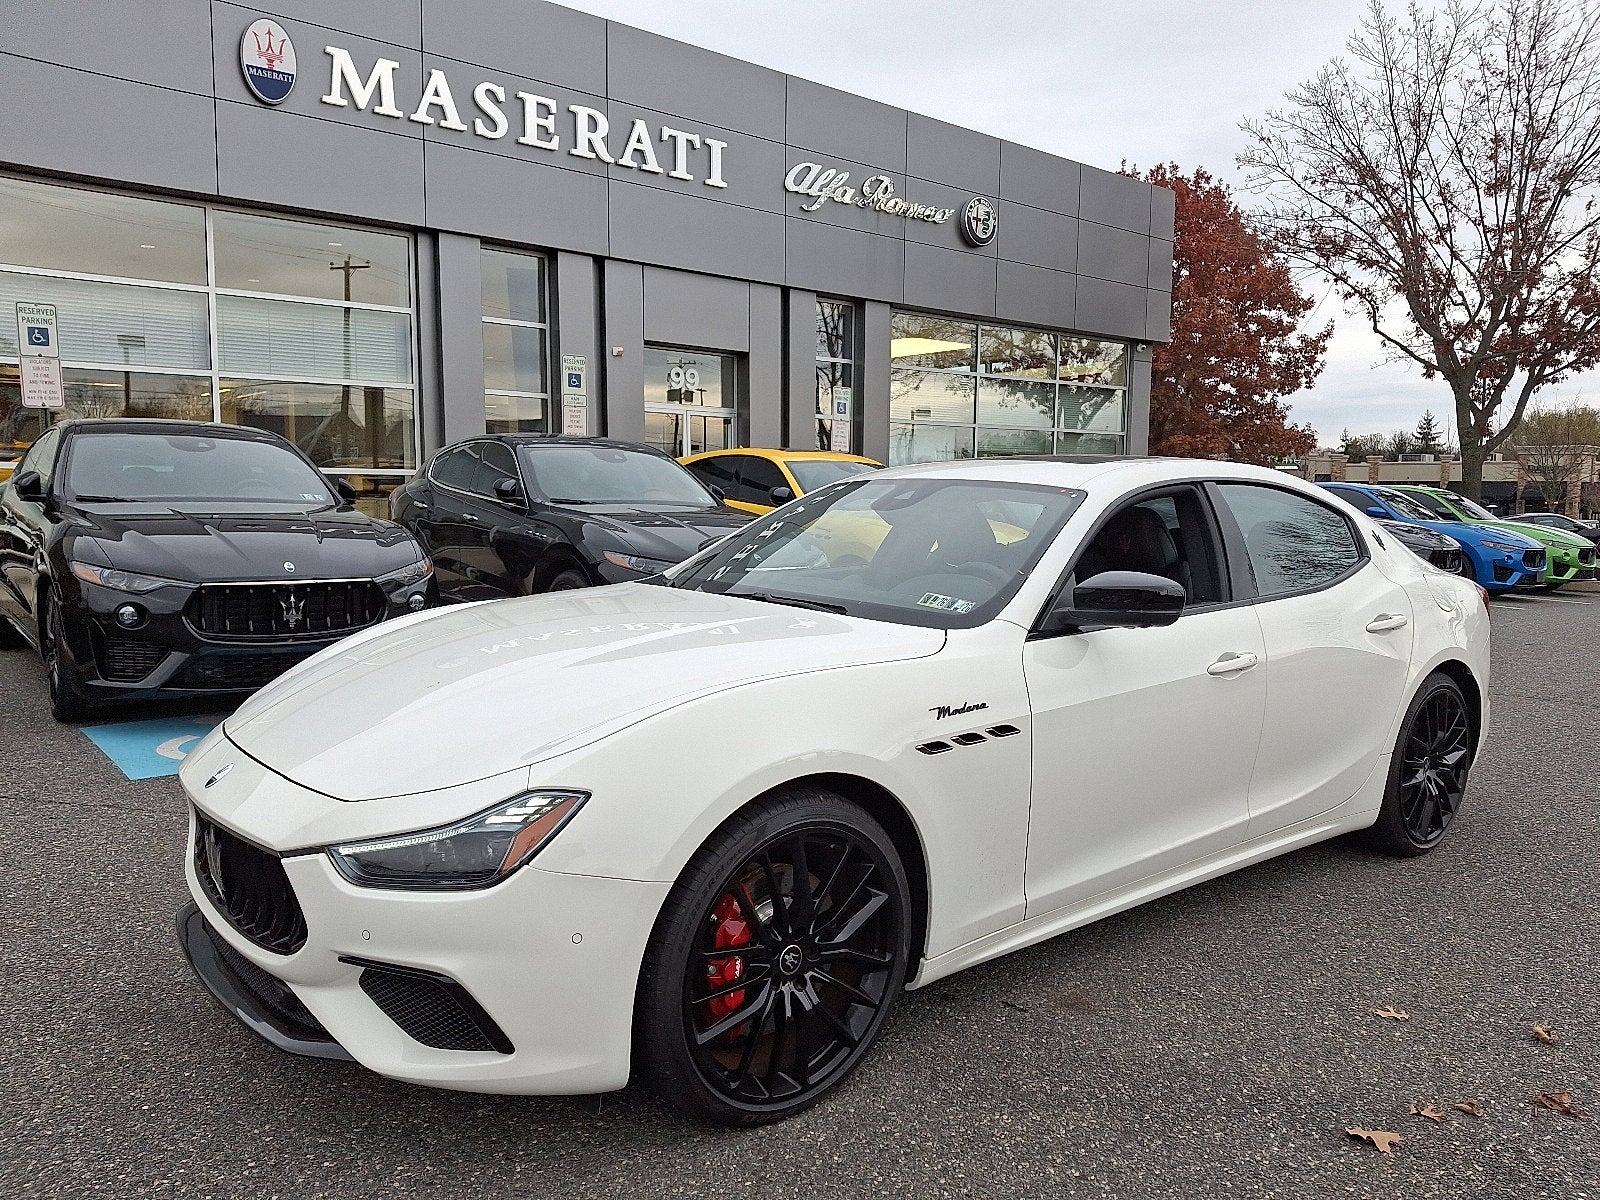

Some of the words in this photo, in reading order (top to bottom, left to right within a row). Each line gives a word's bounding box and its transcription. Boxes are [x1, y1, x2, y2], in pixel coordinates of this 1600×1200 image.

[248, 66, 293, 83] MASERATI
[321, 45, 728, 189] MASERATI
[784, 161, 856, 212] Alfa
[858, 174, 955, 224] Romeo
[18, 306, 55, 316] RESERVED
[21, 316, 53, 326] PARKING
[669, 366, 700, 390] 99
[928, 702, 989, 720] Modena
